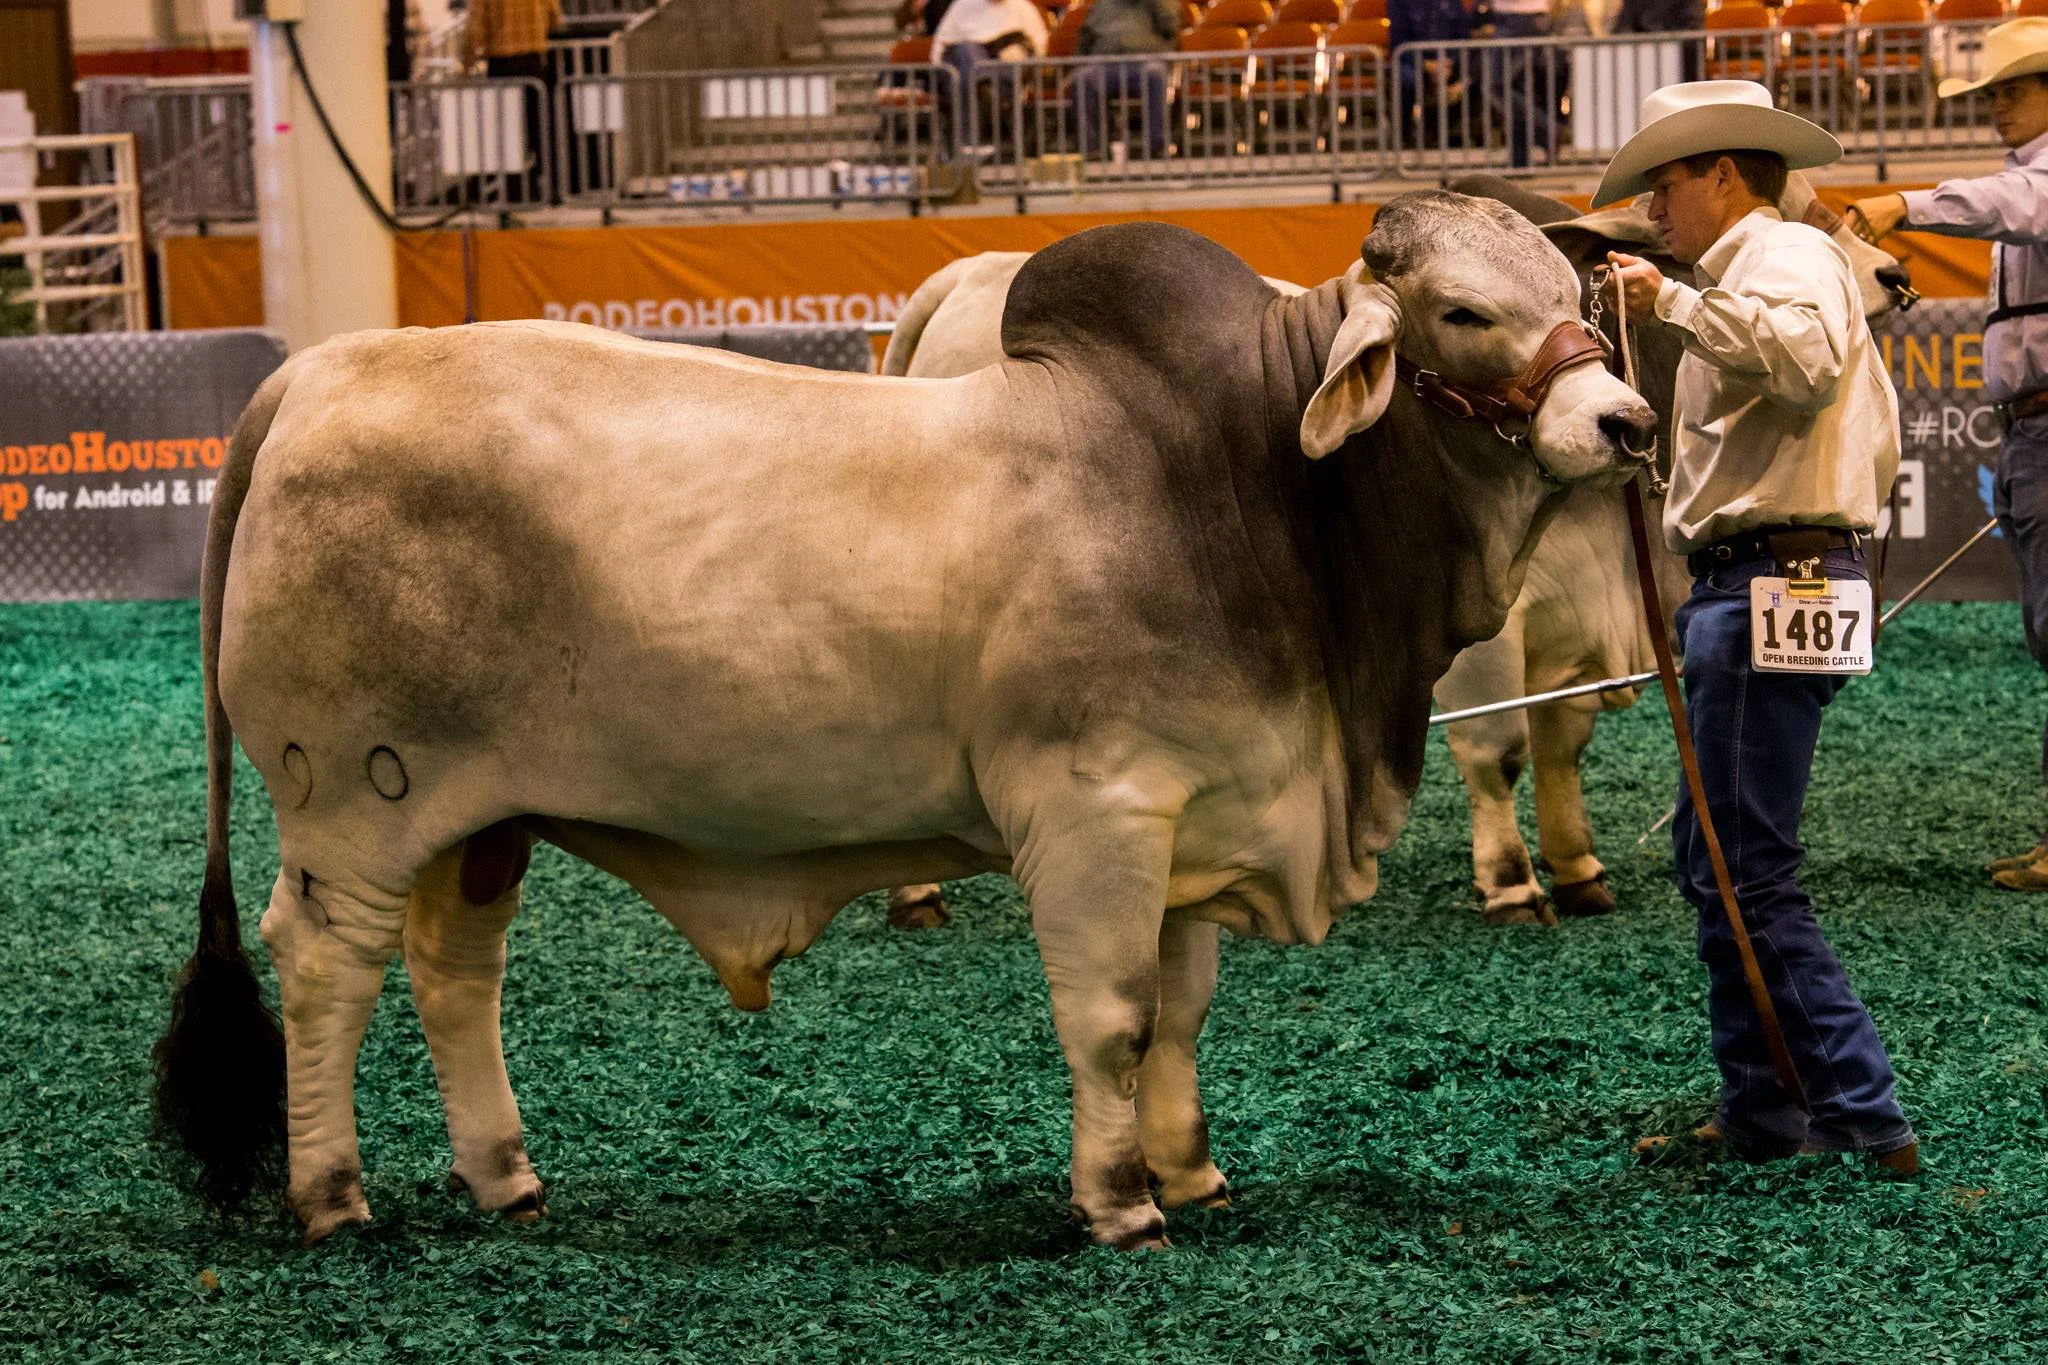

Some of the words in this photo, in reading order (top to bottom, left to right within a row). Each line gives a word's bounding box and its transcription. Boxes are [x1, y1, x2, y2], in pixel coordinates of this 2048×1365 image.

[543, 292, 907, 333] RODEOHOUSTON
[34, 484, 68, 511] for
[74, 480, 165, 509] Android
[172, 479, 191, 505] &
[1762, 607, 1860, 652] 1487
[1762, 652, 1785, 664] OPEN
[1787, 654, 1830, 666] BREEDING
[1832, 656, 1864, 666] CATTLE
